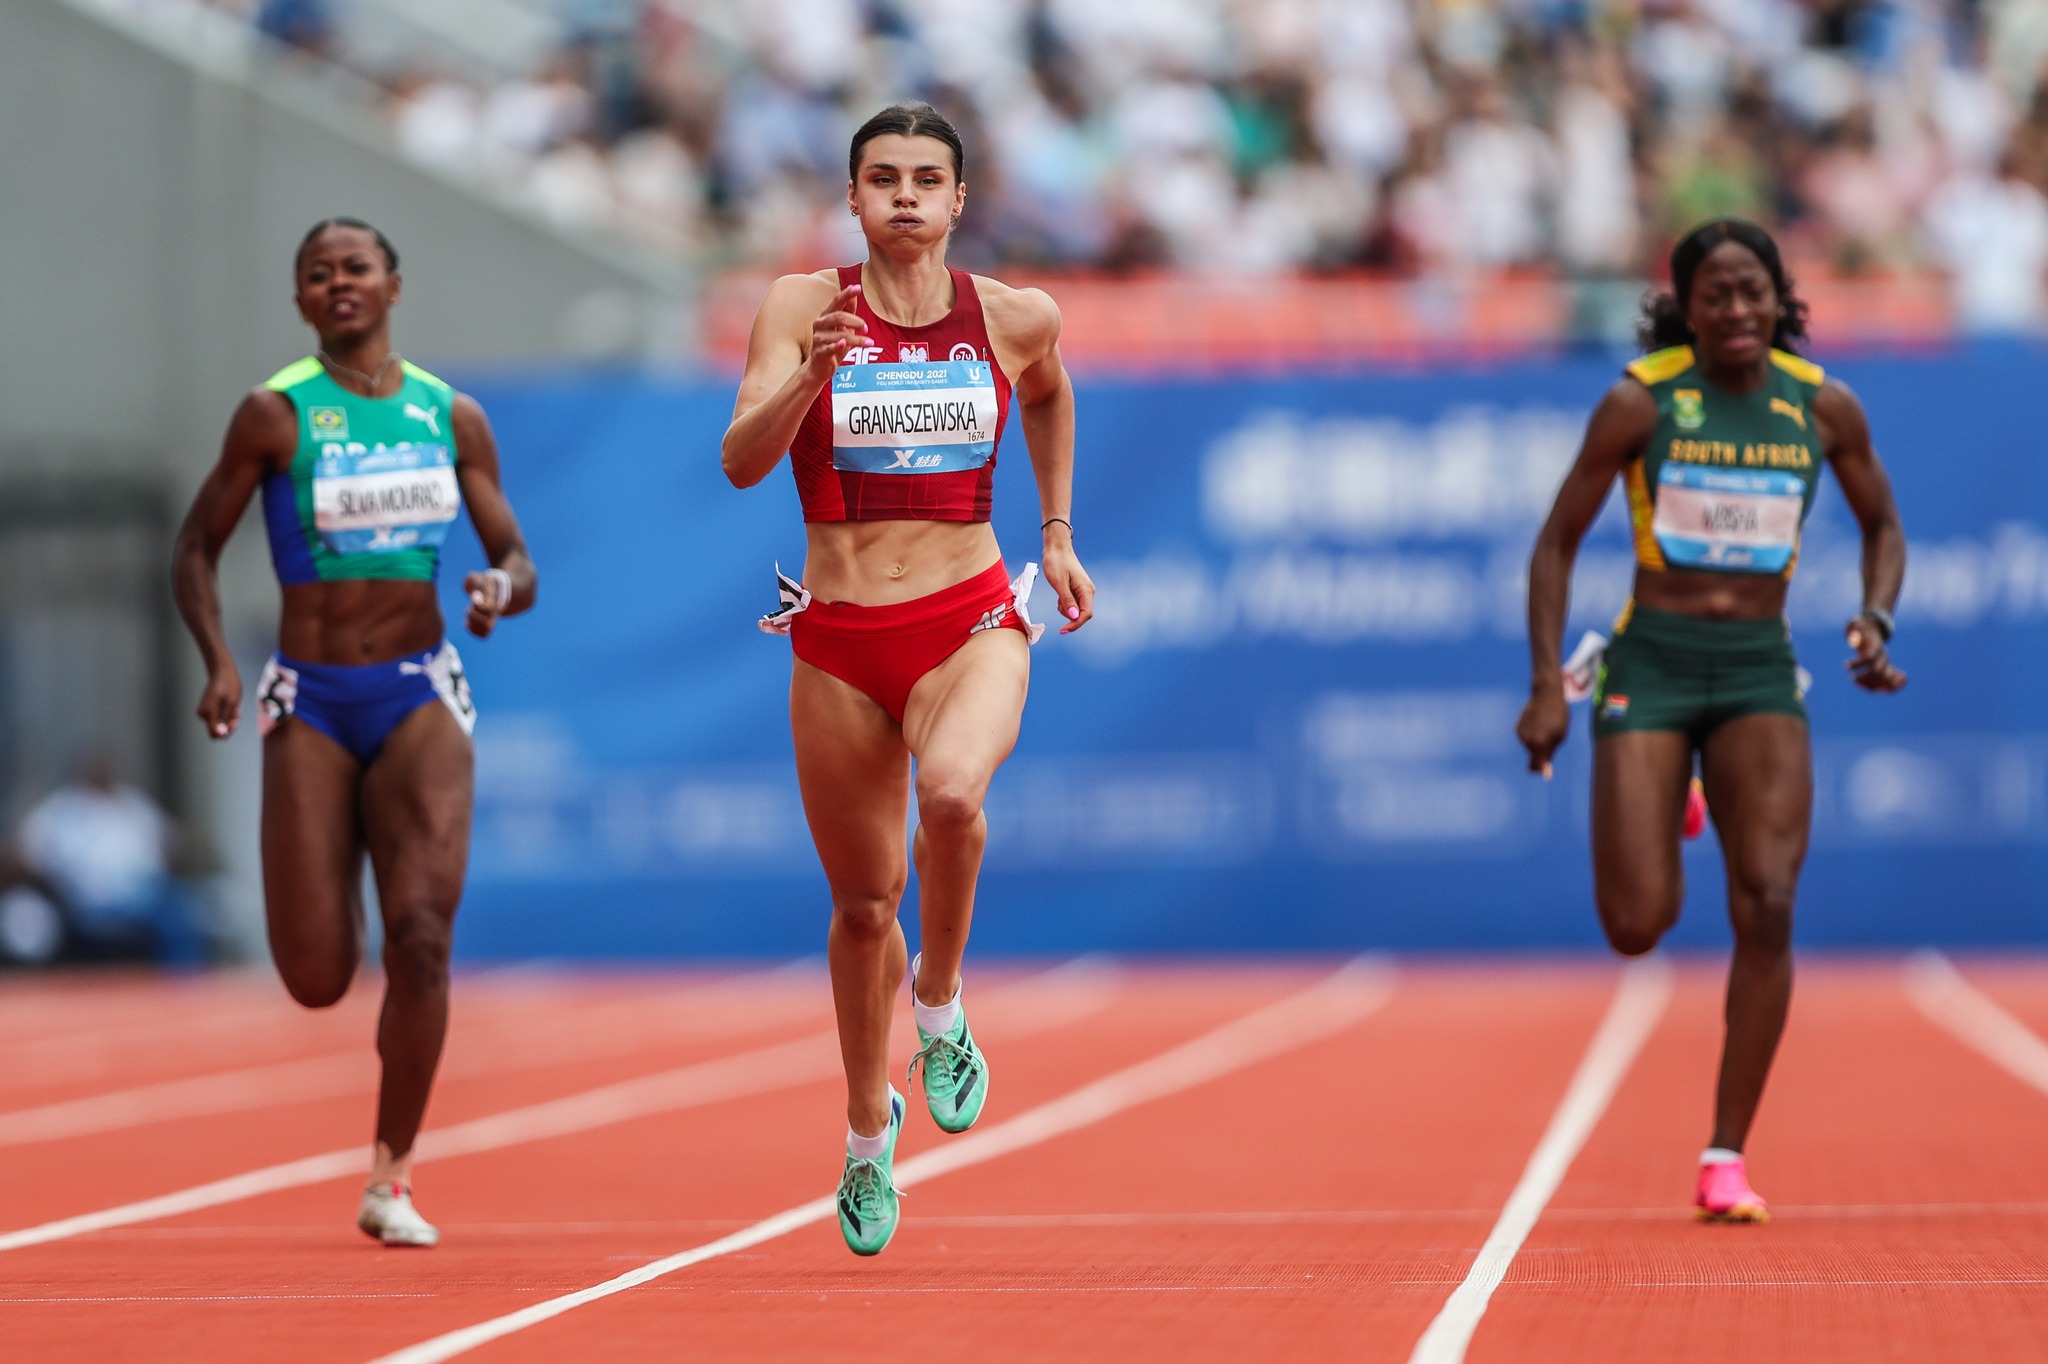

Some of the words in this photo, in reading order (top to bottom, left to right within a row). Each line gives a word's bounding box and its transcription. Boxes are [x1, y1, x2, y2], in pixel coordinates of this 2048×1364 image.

[876, 371, 924, 380] CHENGDU
[926, 370, 947, 379] 2021
[849, 402, 977, 434] GRANASZEWSKA
[967, 431, 985, 442] 1674
[1671, 440, 1736, 464] SOUTH
[1743, 444, 1812, 467] AFRICA
